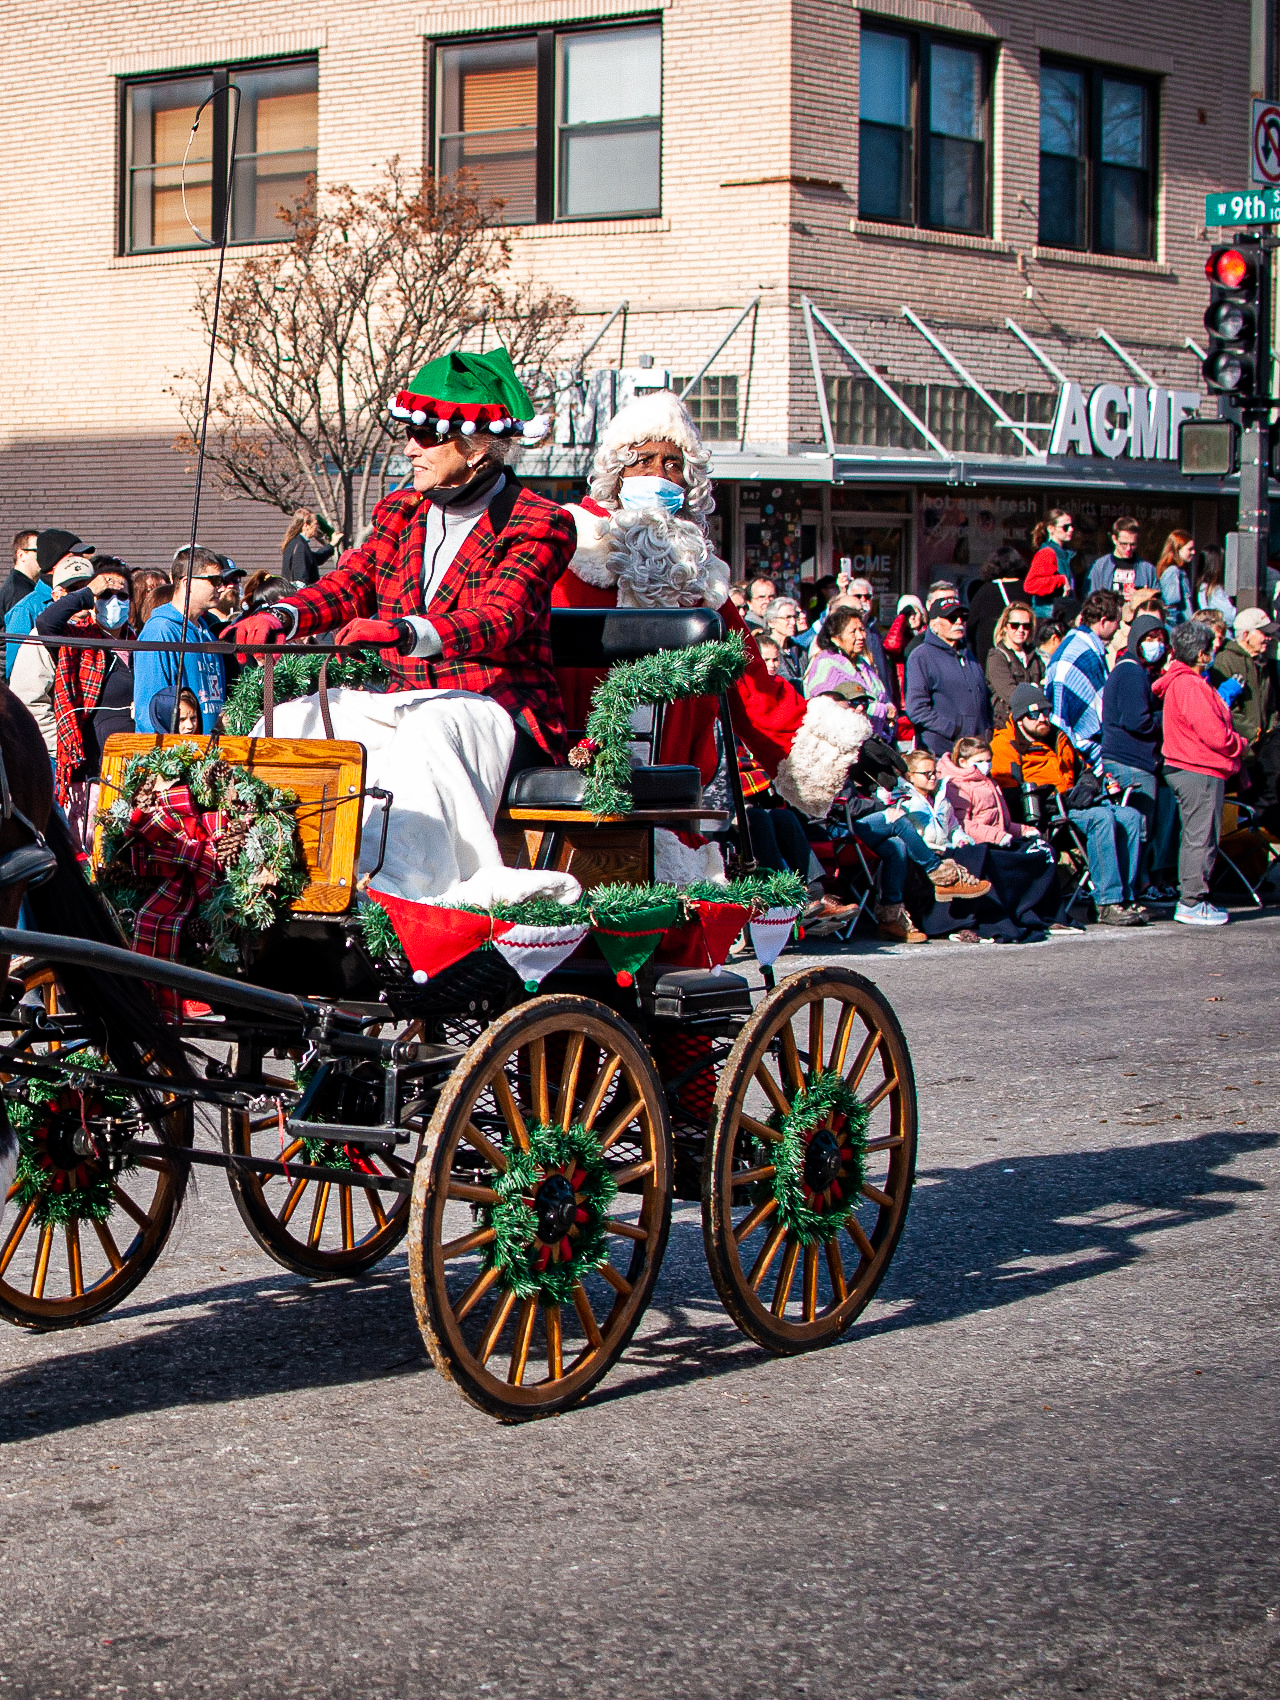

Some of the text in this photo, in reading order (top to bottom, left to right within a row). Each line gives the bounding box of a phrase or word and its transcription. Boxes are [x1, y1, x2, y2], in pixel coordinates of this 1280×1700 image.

[1218, 203, 1227, 216] W
[1231, 195, 1266, 220] 9th
[1049, 382, 1201, 460] ACME
[995, 496, 1038, 513] fresh
[852, 554, 891, 572] CME
